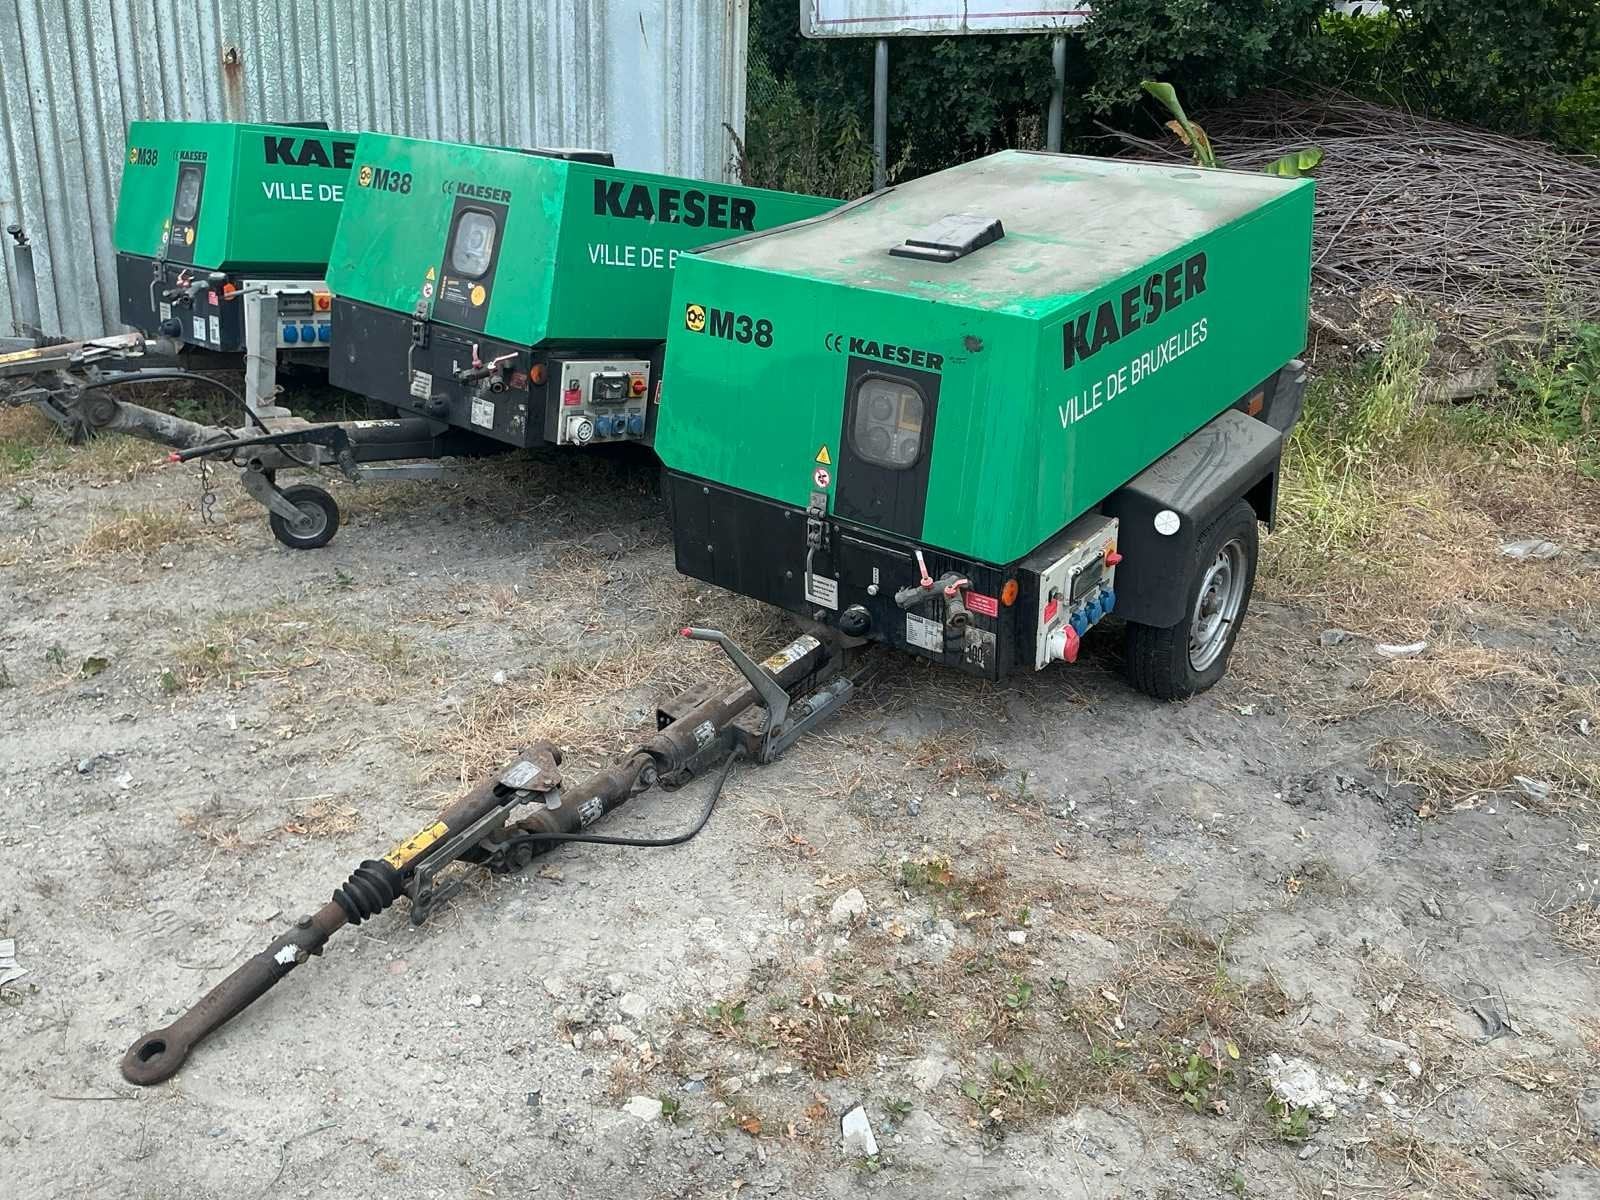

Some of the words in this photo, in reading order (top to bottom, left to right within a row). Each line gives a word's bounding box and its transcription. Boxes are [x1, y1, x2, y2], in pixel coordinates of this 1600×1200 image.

[137, 148, 158, 166] M38
[179, 151, 208, 161] KAESER
[262, 182, 314, 202] VILLE
[318, 184, 344, 202] DE
[373, 167, 412, 195] M38
[457, 182, 512, 203] KAESER
[594, 178, 756, 232] KAESER
[587, 243, 636, 266] VILLE
[641, 247, 665, 268] DE
[1063, 251, 1208, 371] KAESER
[710, 307, 773, 348] M38
[849, 337, 945, 370] KAESER
[1058, 381, 1103, 429] VILLE
[1107, 366, 1128, 401] DE
[1131, 318, 1208, 386] BRUXELLES
